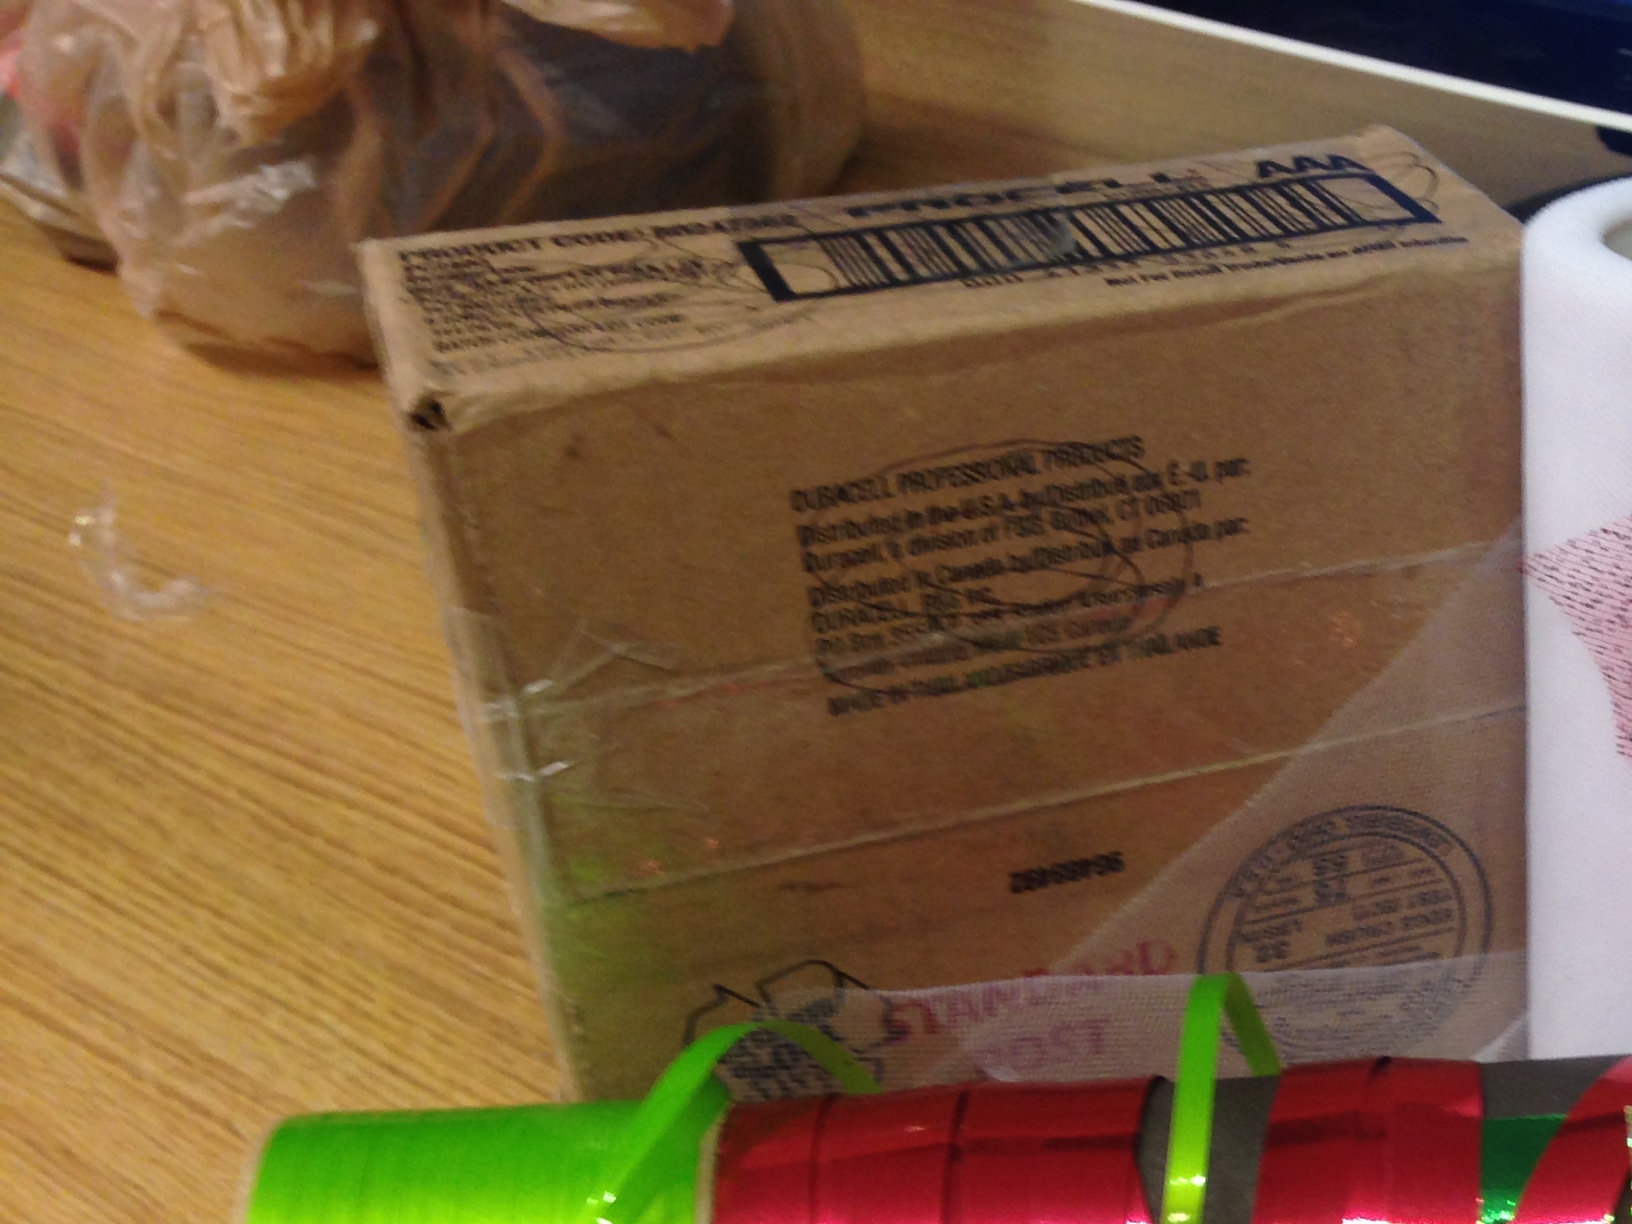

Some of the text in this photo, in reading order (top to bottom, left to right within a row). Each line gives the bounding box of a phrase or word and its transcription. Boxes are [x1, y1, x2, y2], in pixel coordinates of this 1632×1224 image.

[1255, 152, 1374, 179] AAA
[790, 434, 1146, 511] DURACELL PROFESSIONAL PRODUCTS
